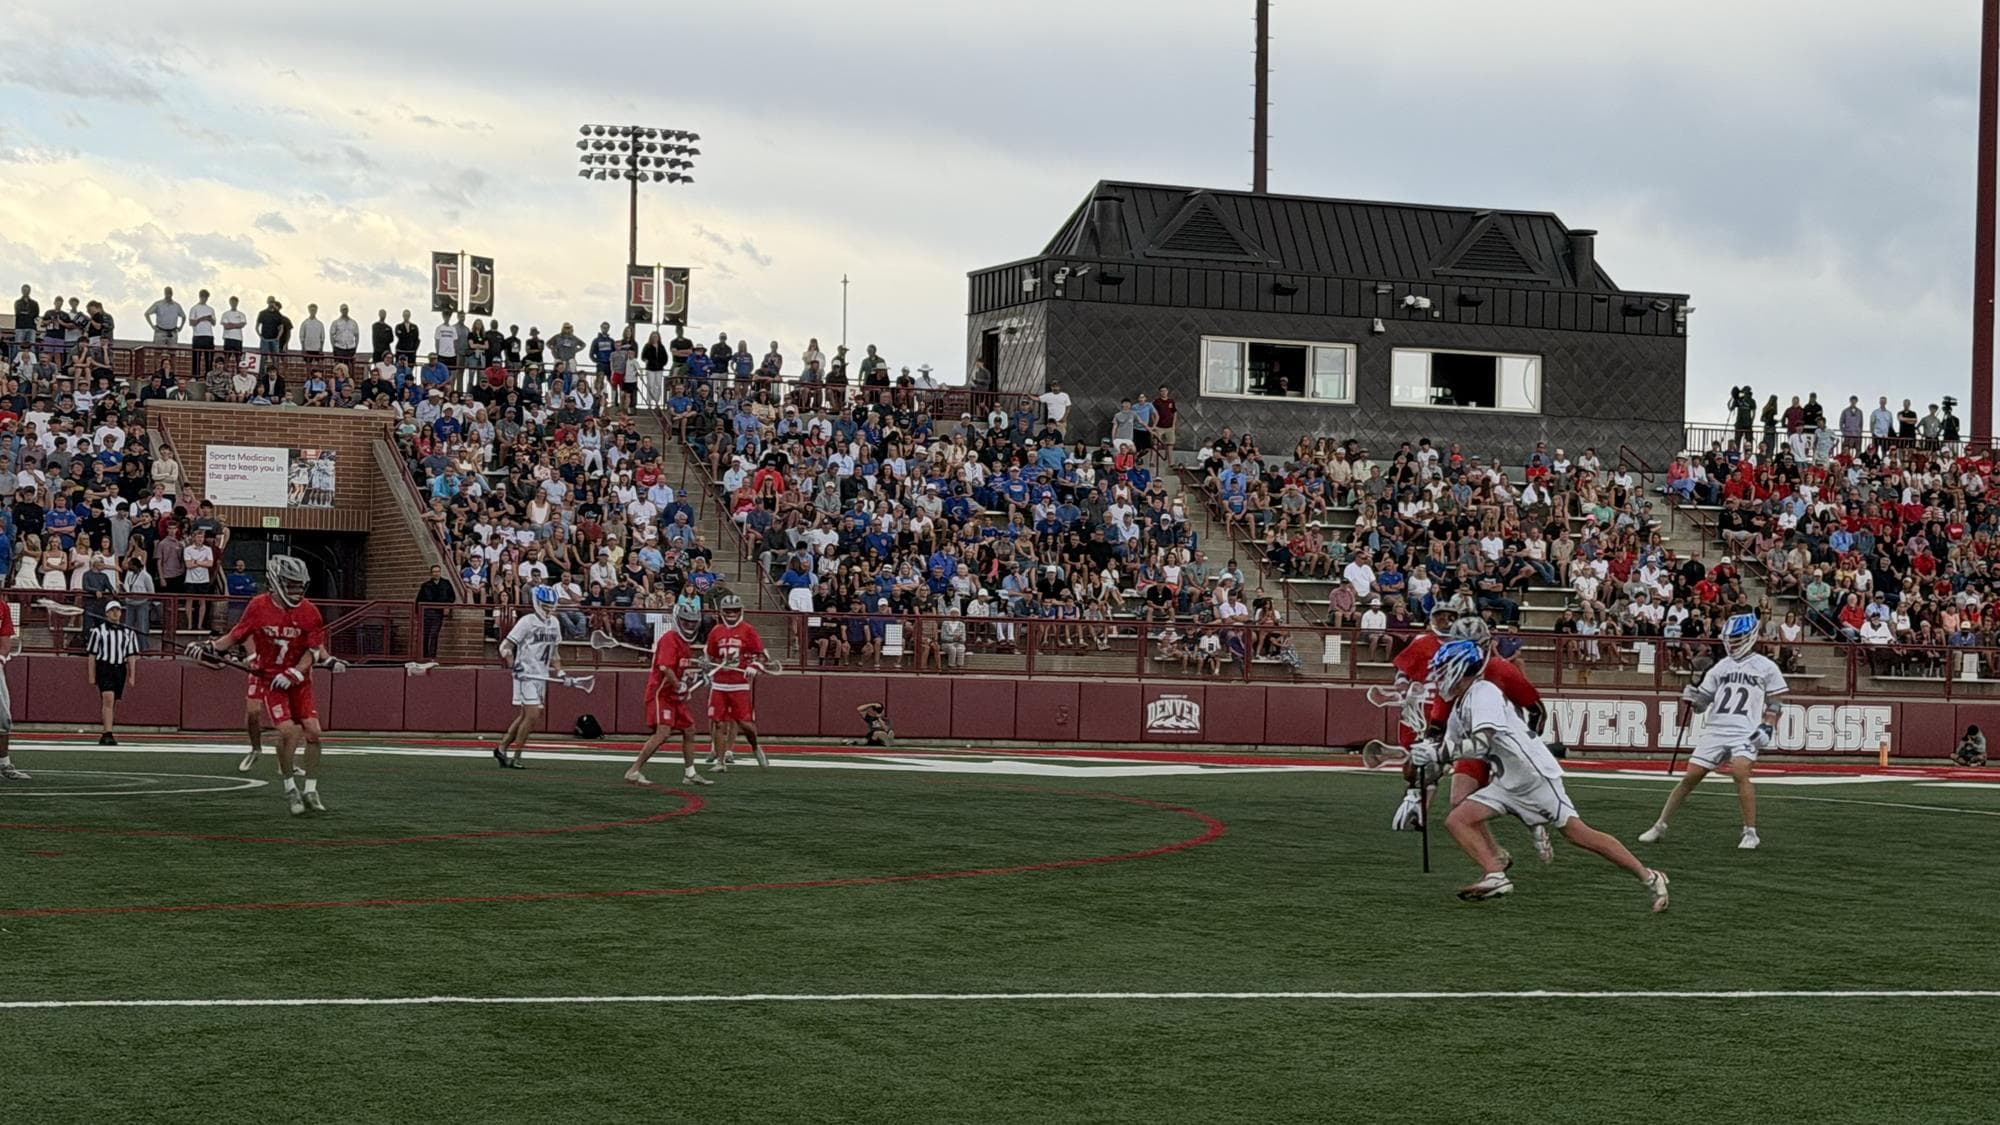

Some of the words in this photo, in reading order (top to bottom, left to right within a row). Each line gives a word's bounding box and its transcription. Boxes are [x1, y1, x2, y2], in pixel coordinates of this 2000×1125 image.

[209, 451, 236, 461] Sports
[238, 453, 275, 462] Medicine
[209, 463, 227, 471] care
[229, 463, 237, 471] to
[239, 464, 259, 473] keep
[260, 465, 275, 473] you
[209, 472, 221, 480] the
[223, 474, 249, 482] game.
[273, 639, 290, 665] 7
[1146, 699, 1201, 730] DENVER
[1716, 687, 1749, 716] 22
[1657, 701, 1892, 752] LOSSE
